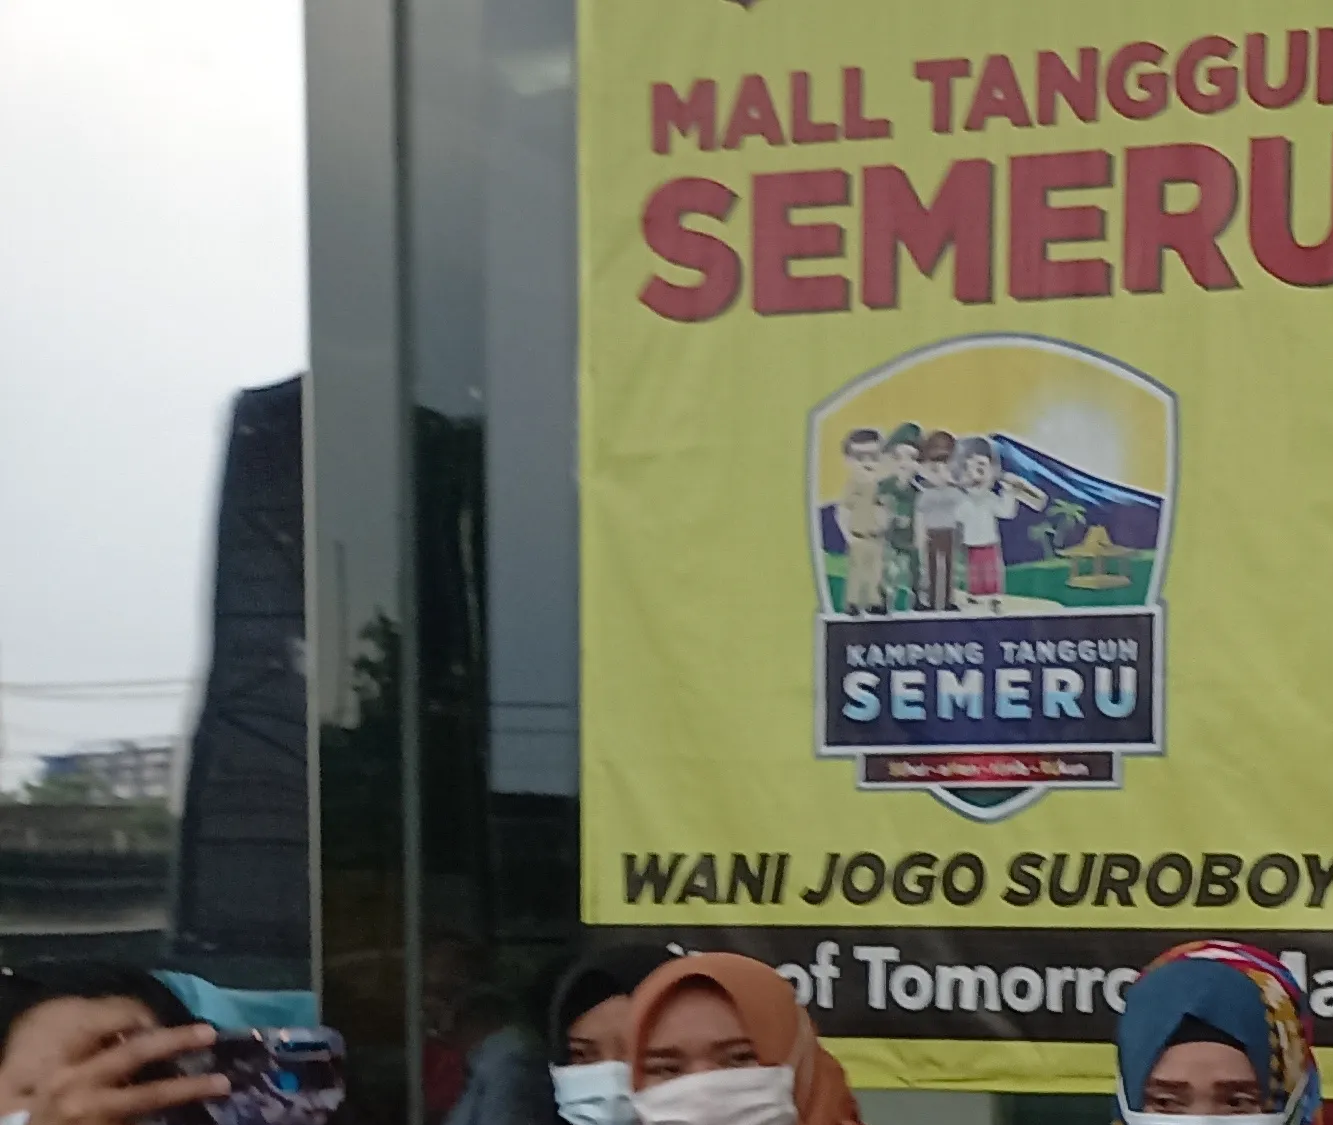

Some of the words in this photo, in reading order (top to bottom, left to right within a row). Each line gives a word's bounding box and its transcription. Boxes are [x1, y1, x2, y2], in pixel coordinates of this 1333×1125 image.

[650, 67, 894, 155] MALL
[845, 641, 985, 668] KAMPUNG
[842, 665, 1138, 722] SEMERU
[621, 852, 791, 906] WANI
[800, 852, 986, 906] JOGO
